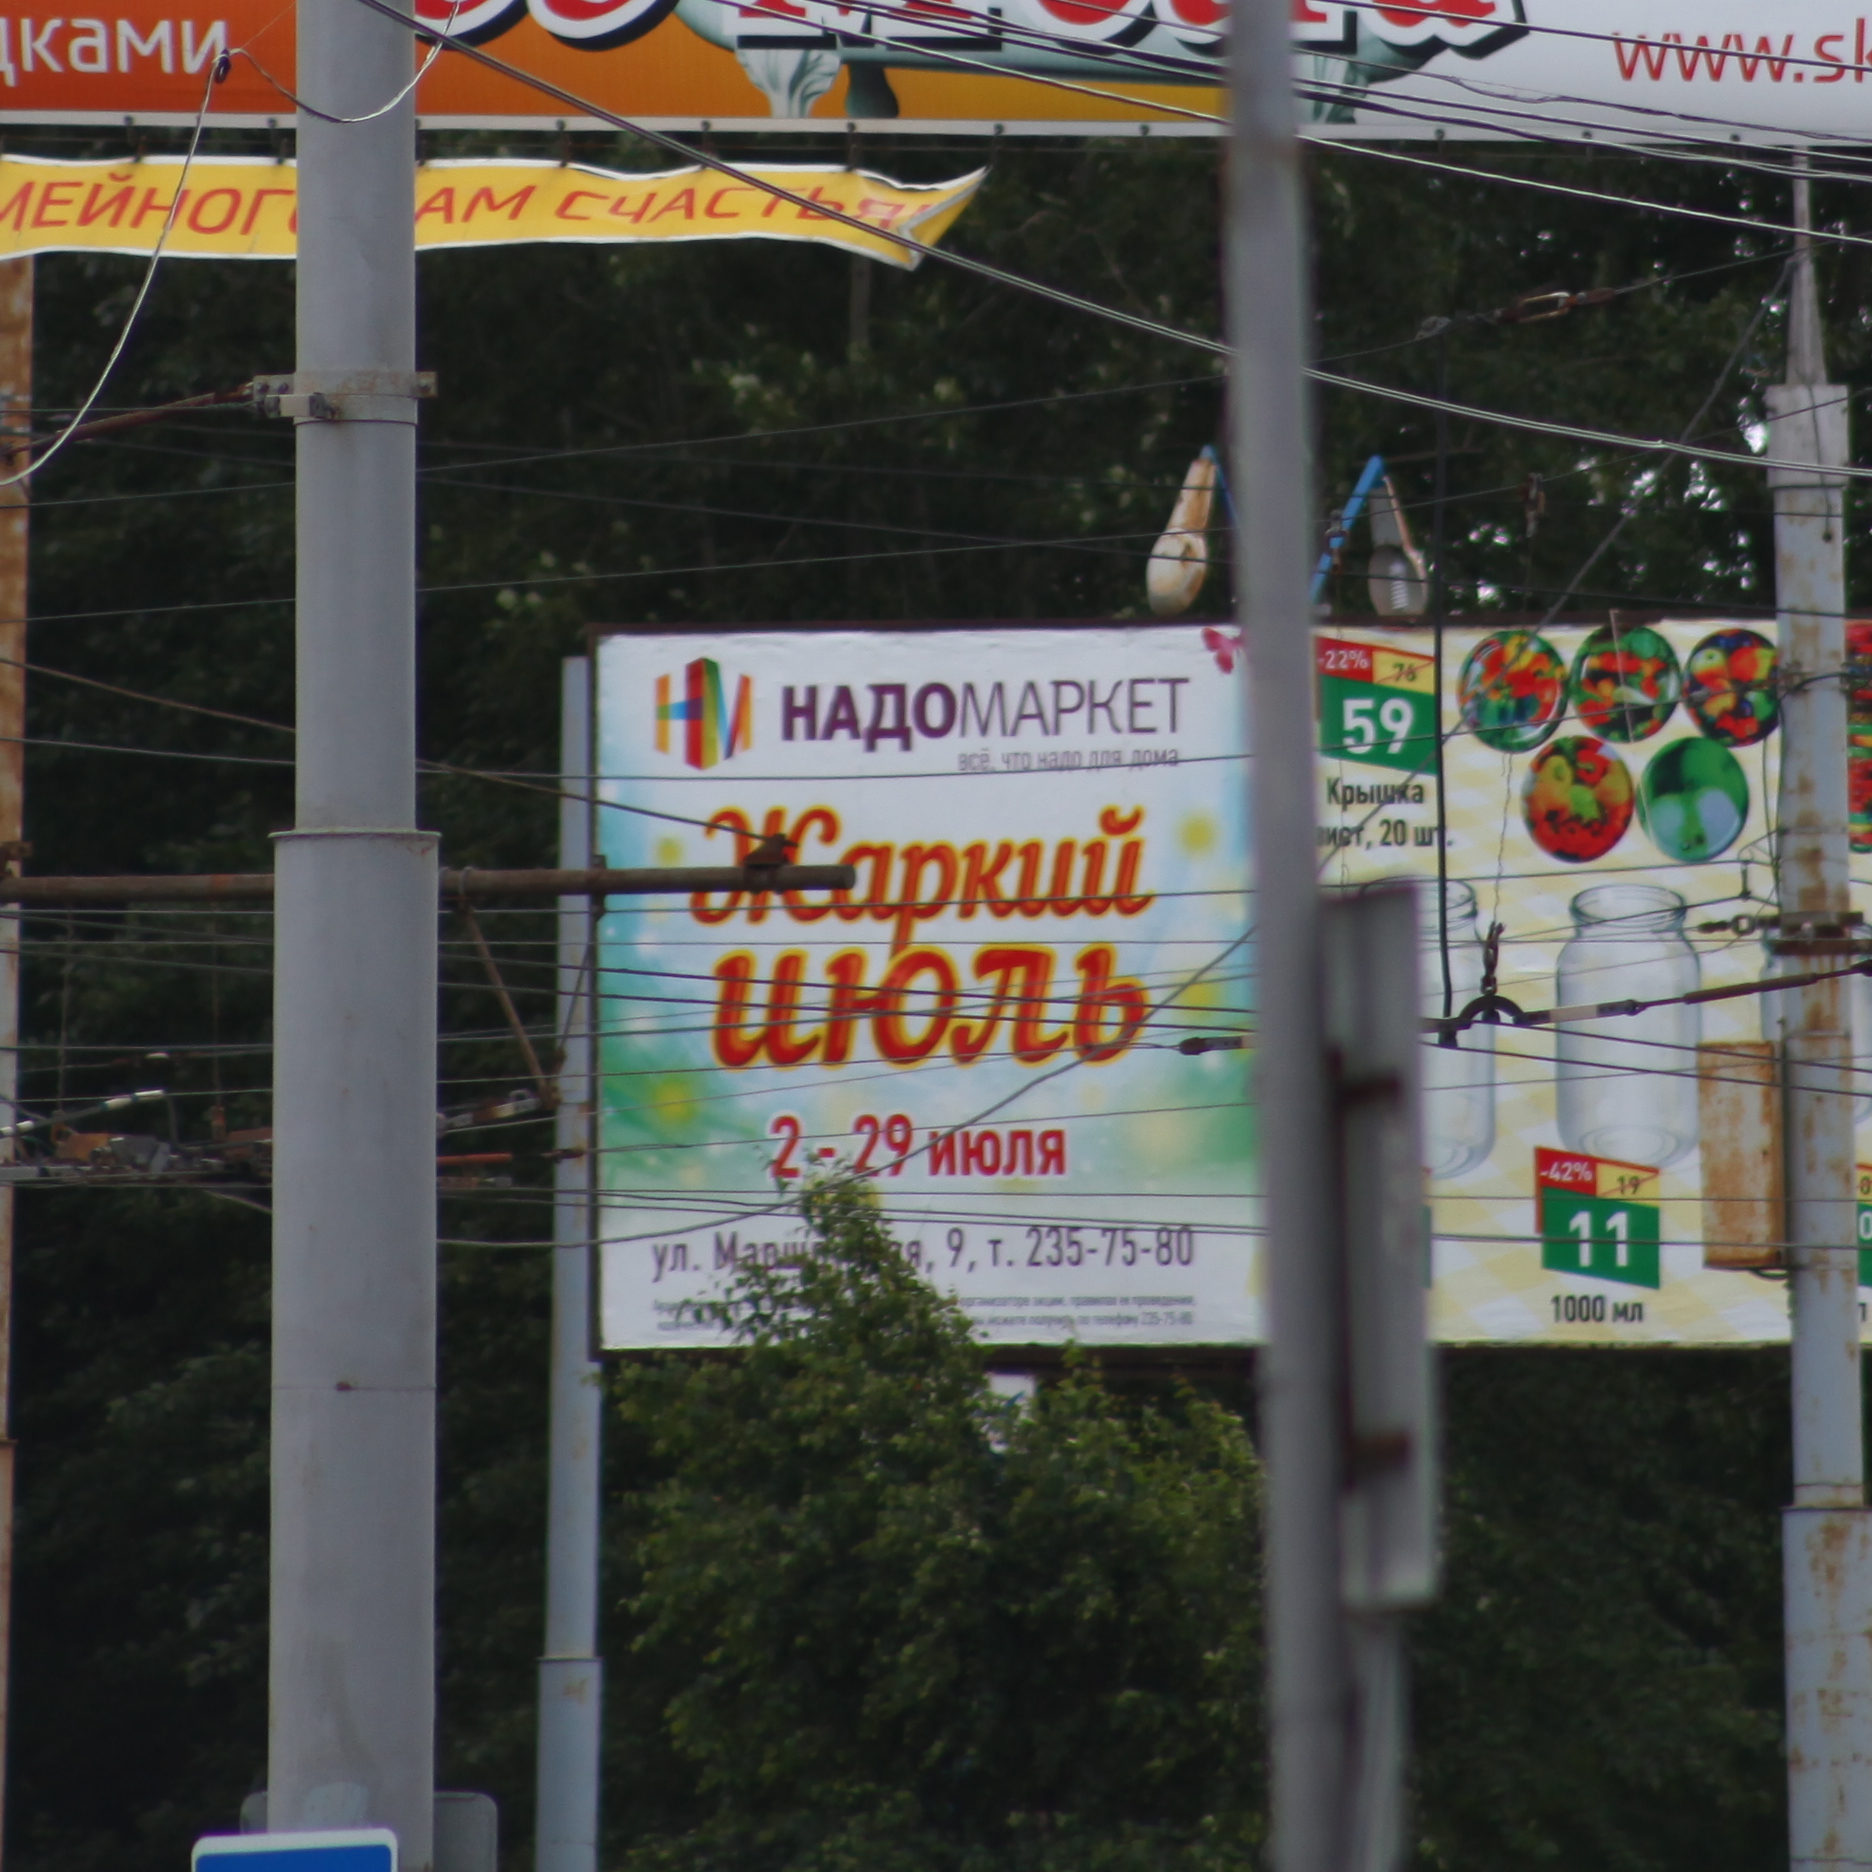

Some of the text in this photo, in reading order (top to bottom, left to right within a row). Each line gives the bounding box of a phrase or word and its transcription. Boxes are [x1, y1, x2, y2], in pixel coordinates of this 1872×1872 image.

[415, 186, 535, 224] АМ
[781, 678, 1190, 753] НАДОМАРКЕТ
[1341, 697, 1415, 755] 59
[1326, 777, 1425, 811] Крышка
[1313, 825, 1372, 851] вист,
[1379, 818, 1407, 847] 20
[688, 804, 1156, 956] Жаркий
[710, 942, 1152, 1069] июль
[770, 1114, 802, 1179] 2
[852, 1113, 914, 1179] 29
[928, 1129, 1066, 1177] июля
[1540, 1160, 1594, 1183] -42%
[652, 1243, 701, 1283] ул.
[946, 1227, 976, 1273] 9,
[988, 1238, 1014, 1268] т.
[1025, 1224, 1195, 1268] 235-75-80
[1568, 1210, 1630, 1268] 11
[1551, 1294, 1645, 1323] 1000 мл
